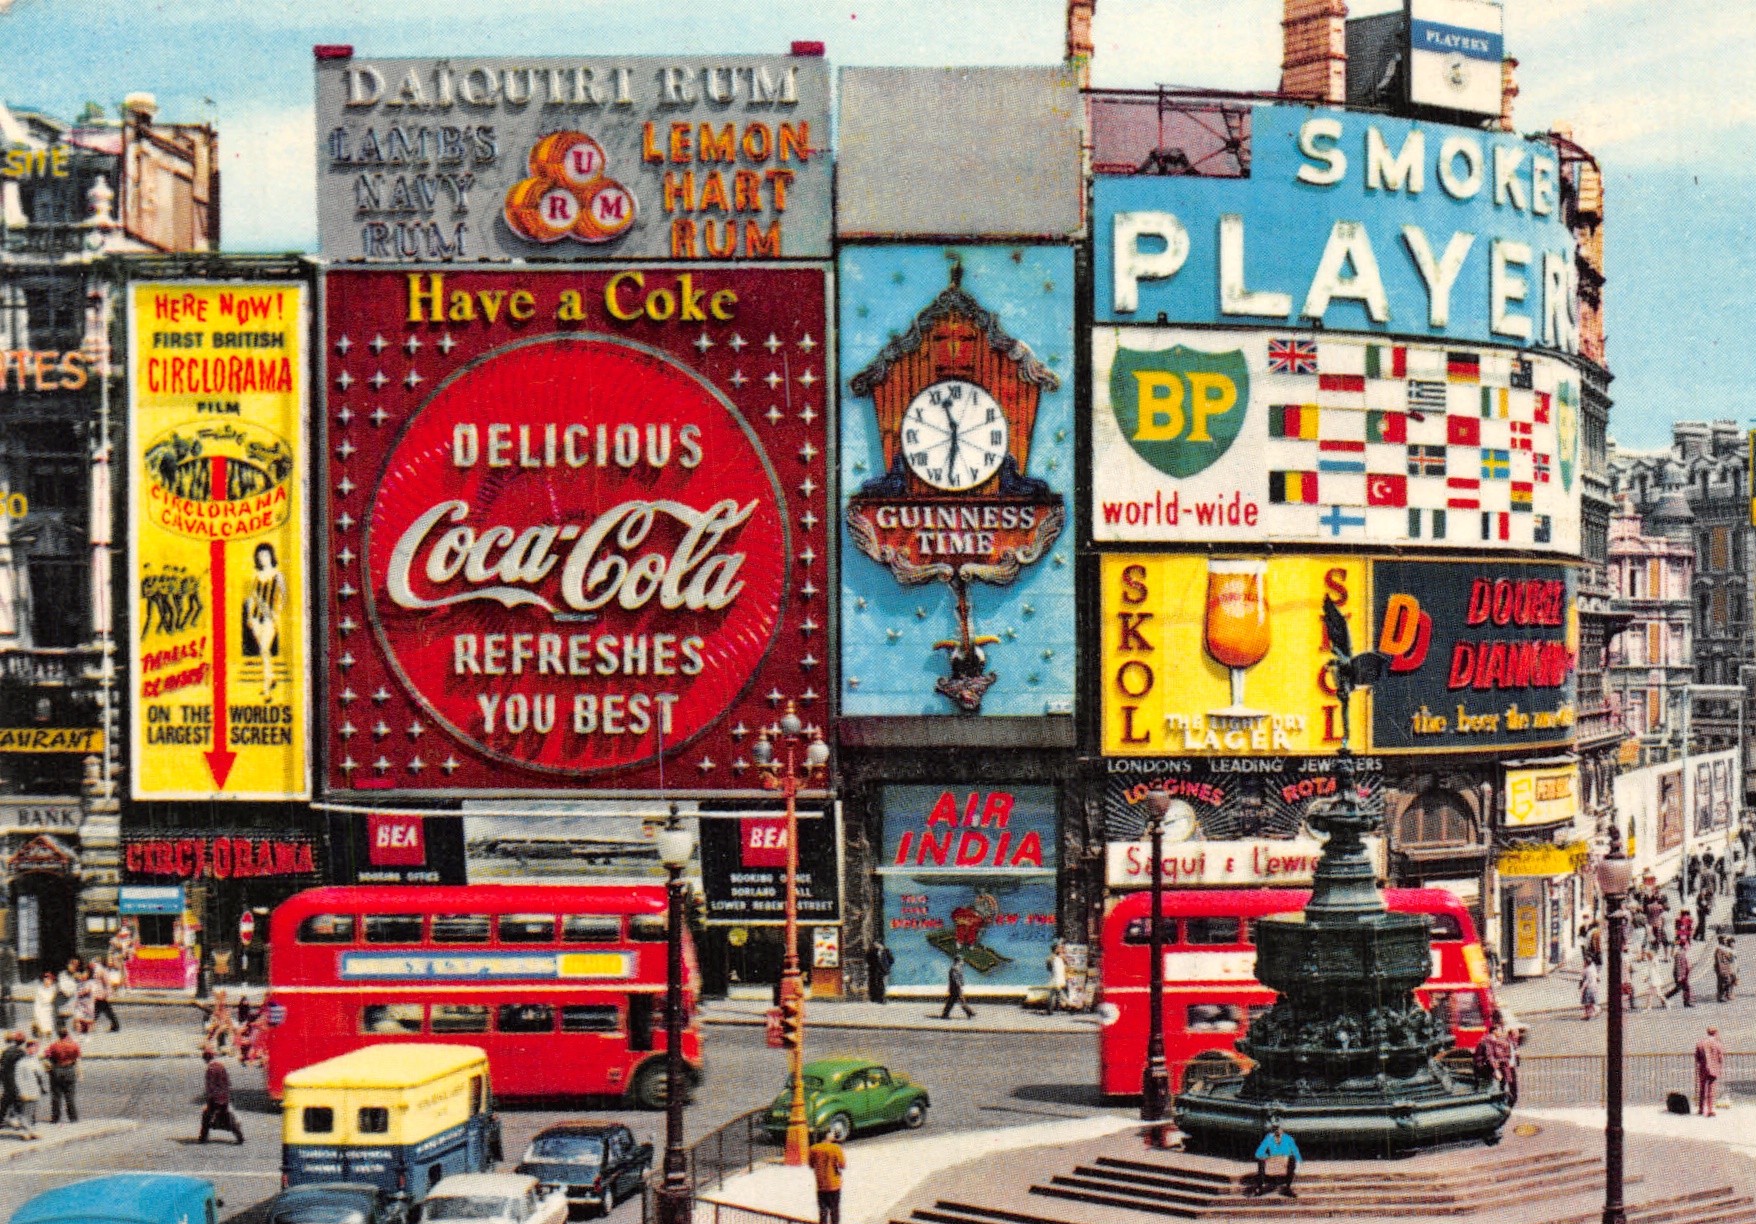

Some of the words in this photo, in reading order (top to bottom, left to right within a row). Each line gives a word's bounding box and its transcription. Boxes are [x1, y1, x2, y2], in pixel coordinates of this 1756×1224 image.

[661, 66, 799, 105] RUM
[643, 121, 809, 164] LEMON
[1297, 119, 1553, 215] SMOKE
[355, 173, 477, 213] NAVY
[665, 170, 795, 212] HART
[365, 222, 467, 257] RUM
[671, 220, 783, 258] RUM
[155, 293, 208, 323] HERE
[219, 293, 283, 326] NOW!
[407, 273, 534, 324] Have
[562, 290, 585, 322] a
[605, 271, 737, 322] Coke
[152, 332, 204, 348] FIRST
[212, 332, 285, 349] BRITISH
[148, 355, 292, 395] CIRCLORAMA
[197, 401, 240, 415] FILM
[1131, 370, 1238, 442] BP
[453, 422, 703, 468] DELICIOUS
[151, 484, 287, 518] CIRCLORAMA
[876, 506, 1036, 530] GUINNESS
[1102, 490, 1259, 526] world-wide
[161, 511, 274, 537] CAVALCADE
[387, 498, 759, 612] Coca-Cola
[916, 531, 994, 555] TIME
[455, 633, 704, 676] REFRESHES
[1116, 564, 1155, 744] SKOL
[148, 705, 170, 723] ON
[180, 705, 212, 723] THE
[229, 705, 292, 723] WORLD'S
[477, 693, 555, 735] YOU
[575, 693, 679, 735] BEST
[1165, 715, 1200, 729] THE
[1271, 715, 1308, 729] DRY
[147, 726, 212, 745] LARGEST
[230, 726, 292, 745] SCREEN
[1184, 731, 1291, 751] LAGER
[1211, 758, 1284, 774] LEADING
[18, 808, 77, 827] BANK
[927, 791, 1015, 828] AIR
[376, 824, 418, 848] BEA
[749, 826, 788, 848] BEA
[895, 831, 1043, 868] INDIA
[752, 900, 787, 911] REGEN
